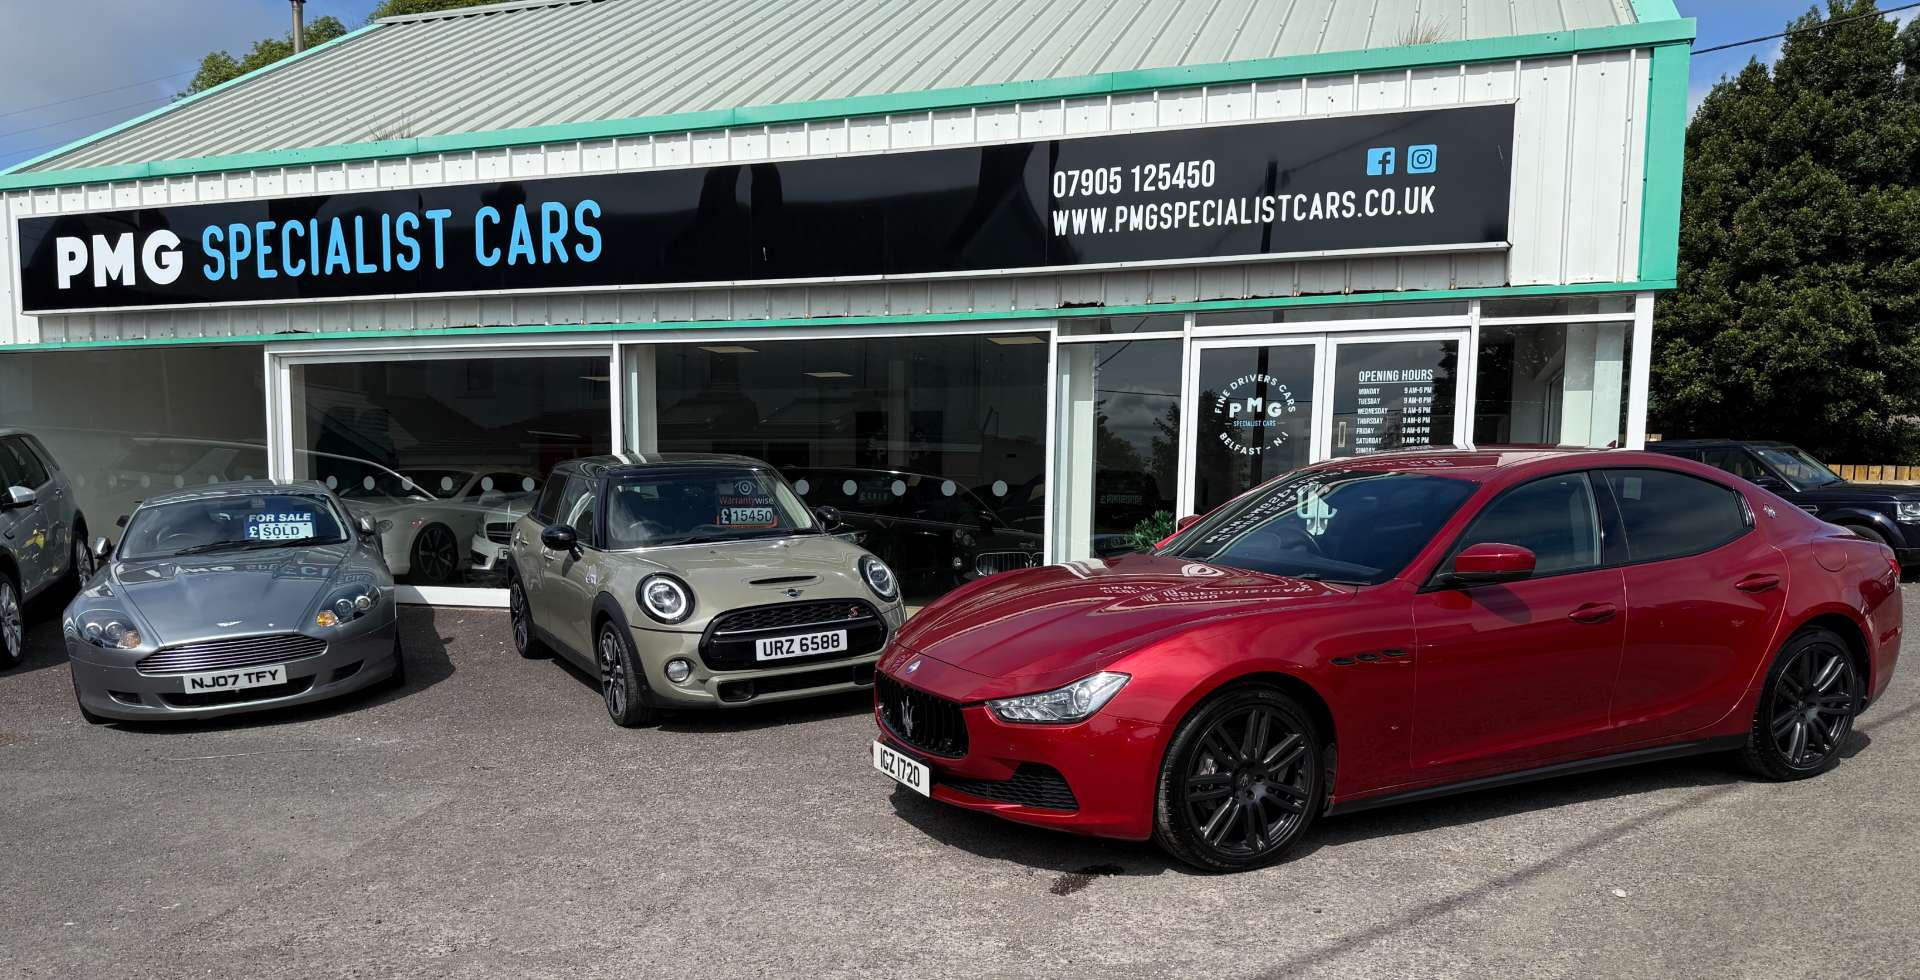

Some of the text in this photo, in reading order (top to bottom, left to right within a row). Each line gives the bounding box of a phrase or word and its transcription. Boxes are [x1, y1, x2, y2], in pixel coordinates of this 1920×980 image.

[1053, 159, 1216, 198] 07905 125450
[1052, 185, 1436, 237] WWW.PMGSPECIALISTCARS.CO.UK
[56, 199, 602, 290] PMG SPECIALIST CARS
[1359, 369, 1433, 381] OPENING HOURS
[1214, 374, 1296, 414] FINE DRIVERS CARS
[1229, 397, 1282, 418] PMG
[1420, 436, 1430, 444] PM
[1421, 426, 1430, 434] PM
[1219, 432, 1261, 455] BELFAST
[249, 513, 312, 522] FOR SALE
[263, 526, 299, 536] SOLD
[763, 633, 840, 657] URZ 6588
[190, 669, 278, 690] NJ07 TFY
[880, 747, 920, 788] IGZ 1720
